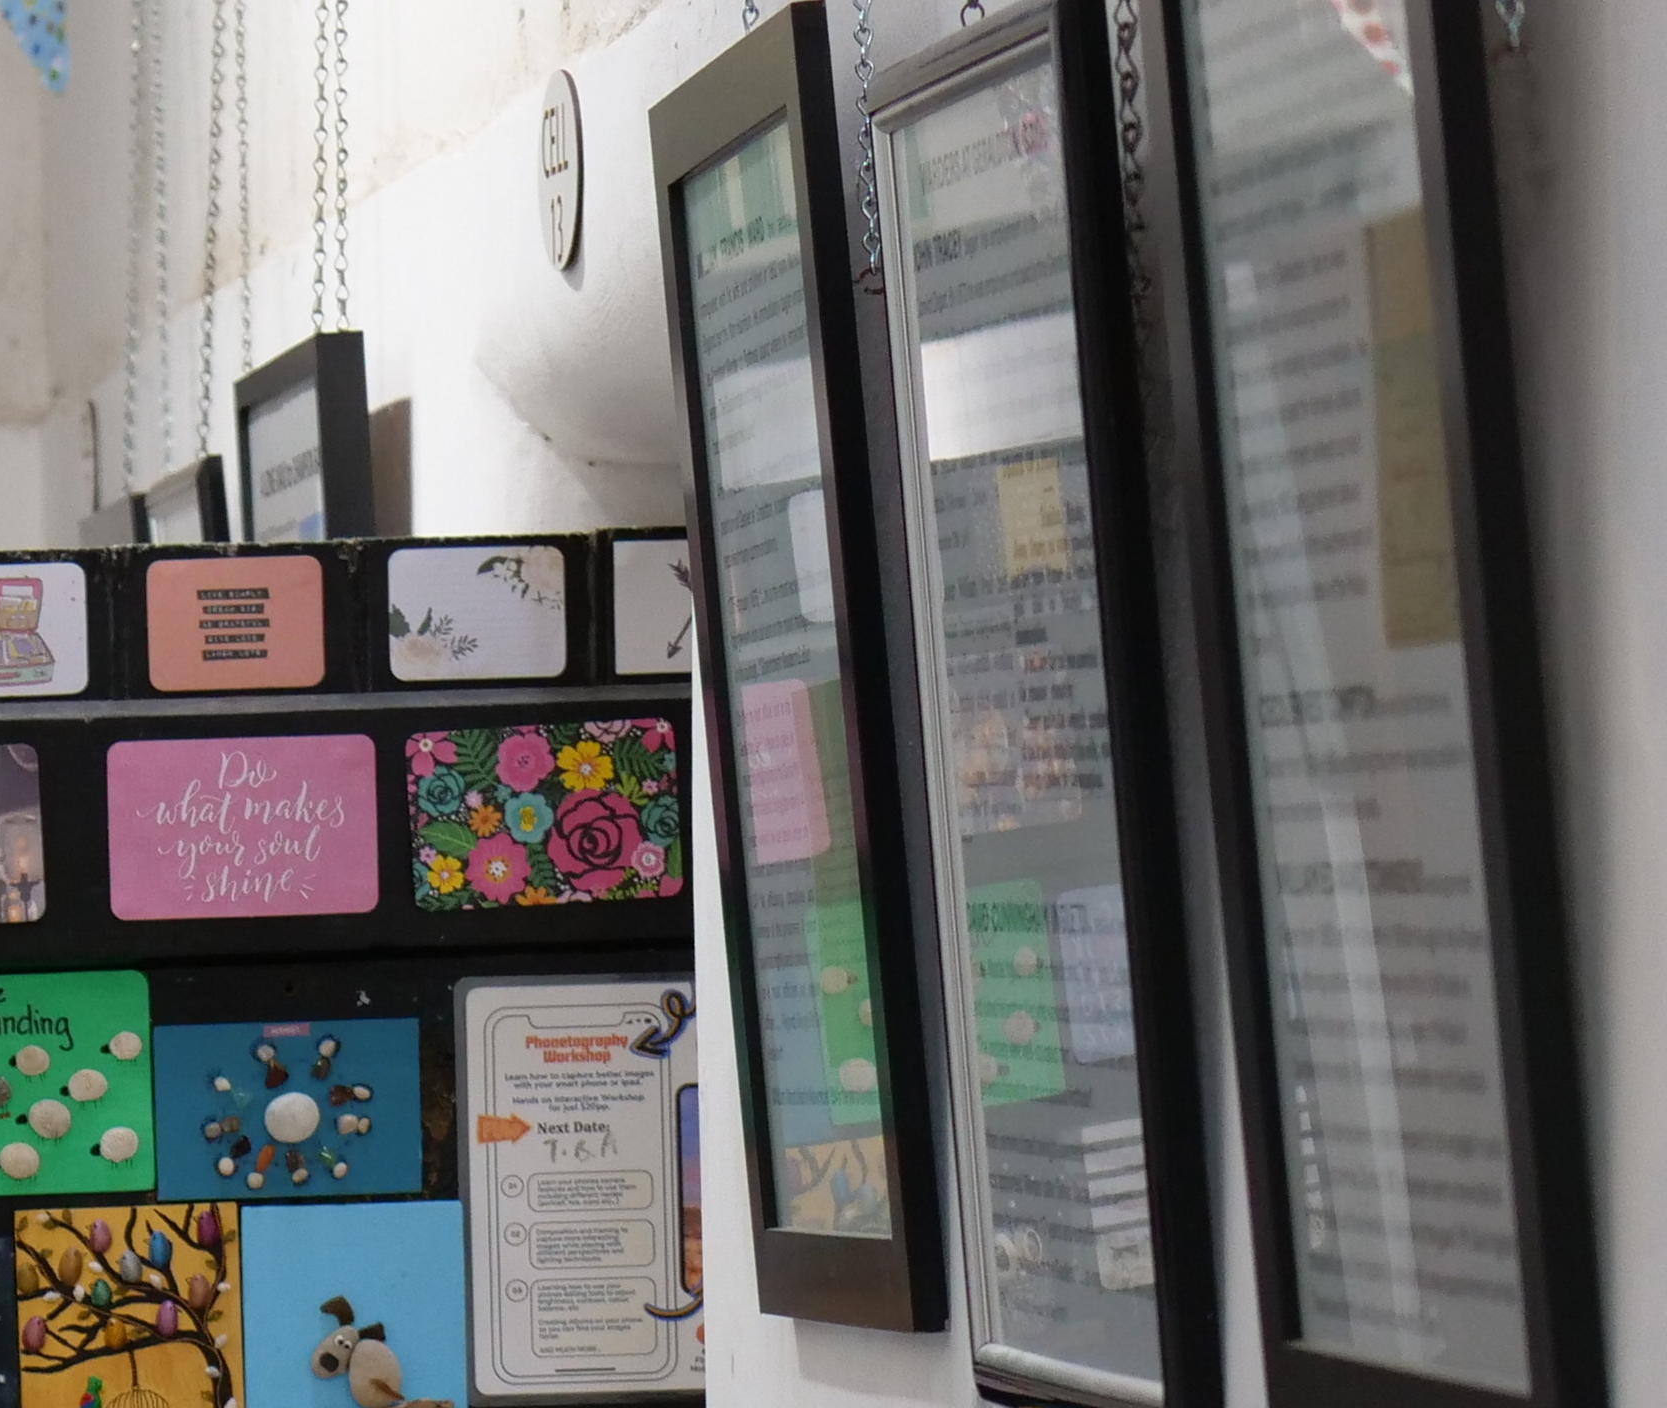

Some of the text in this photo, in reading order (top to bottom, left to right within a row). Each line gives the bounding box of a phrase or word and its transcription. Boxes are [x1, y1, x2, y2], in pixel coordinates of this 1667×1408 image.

[542, 103, 568, 179] CELL
[218, 751, 277, 789] Do
[136, 778, 345, 834] what makes
[157, 824, 321, 880] your soul
[201, 865, 295, 903] shine
[543, 1049, 611, 1064] Workshop
[537, 1121, 611, 1135] Next Date:
